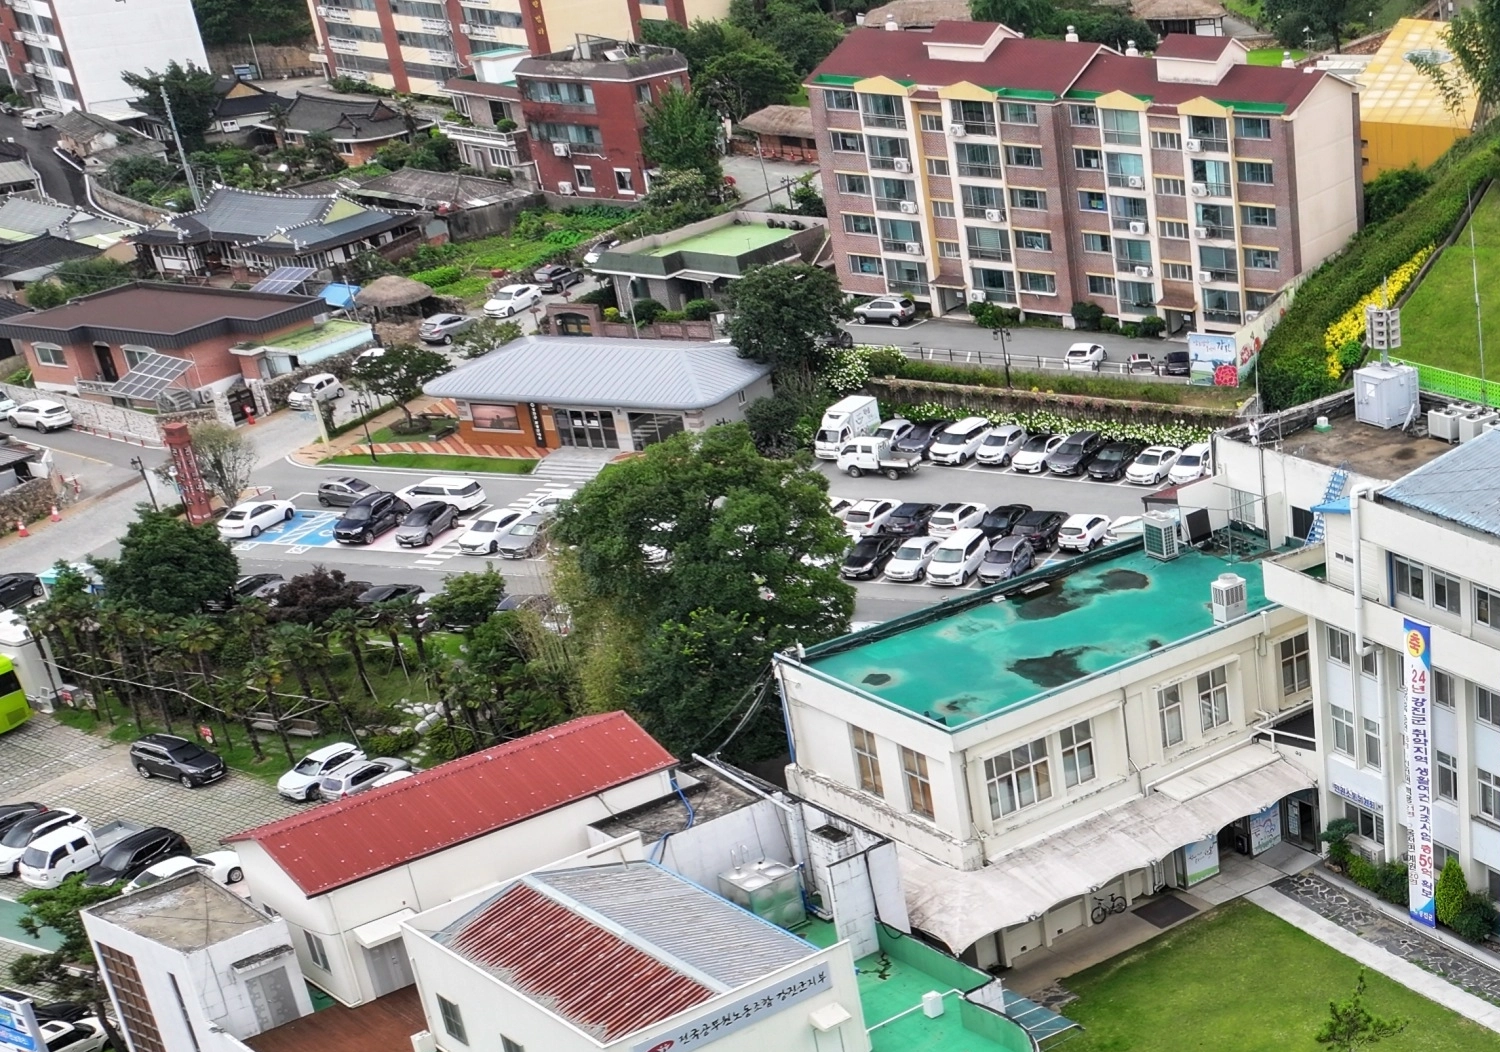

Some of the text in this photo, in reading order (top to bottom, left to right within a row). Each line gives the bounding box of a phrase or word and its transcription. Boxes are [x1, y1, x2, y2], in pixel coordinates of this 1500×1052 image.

[1408, 633, 1421, 653] 축
[1411, 697, 1427, 726] 강진군
[1412, 729, 1429, 765] 취약지역
[678, 971, 826, 1045] 전국공무원노동조합 강진군지부
